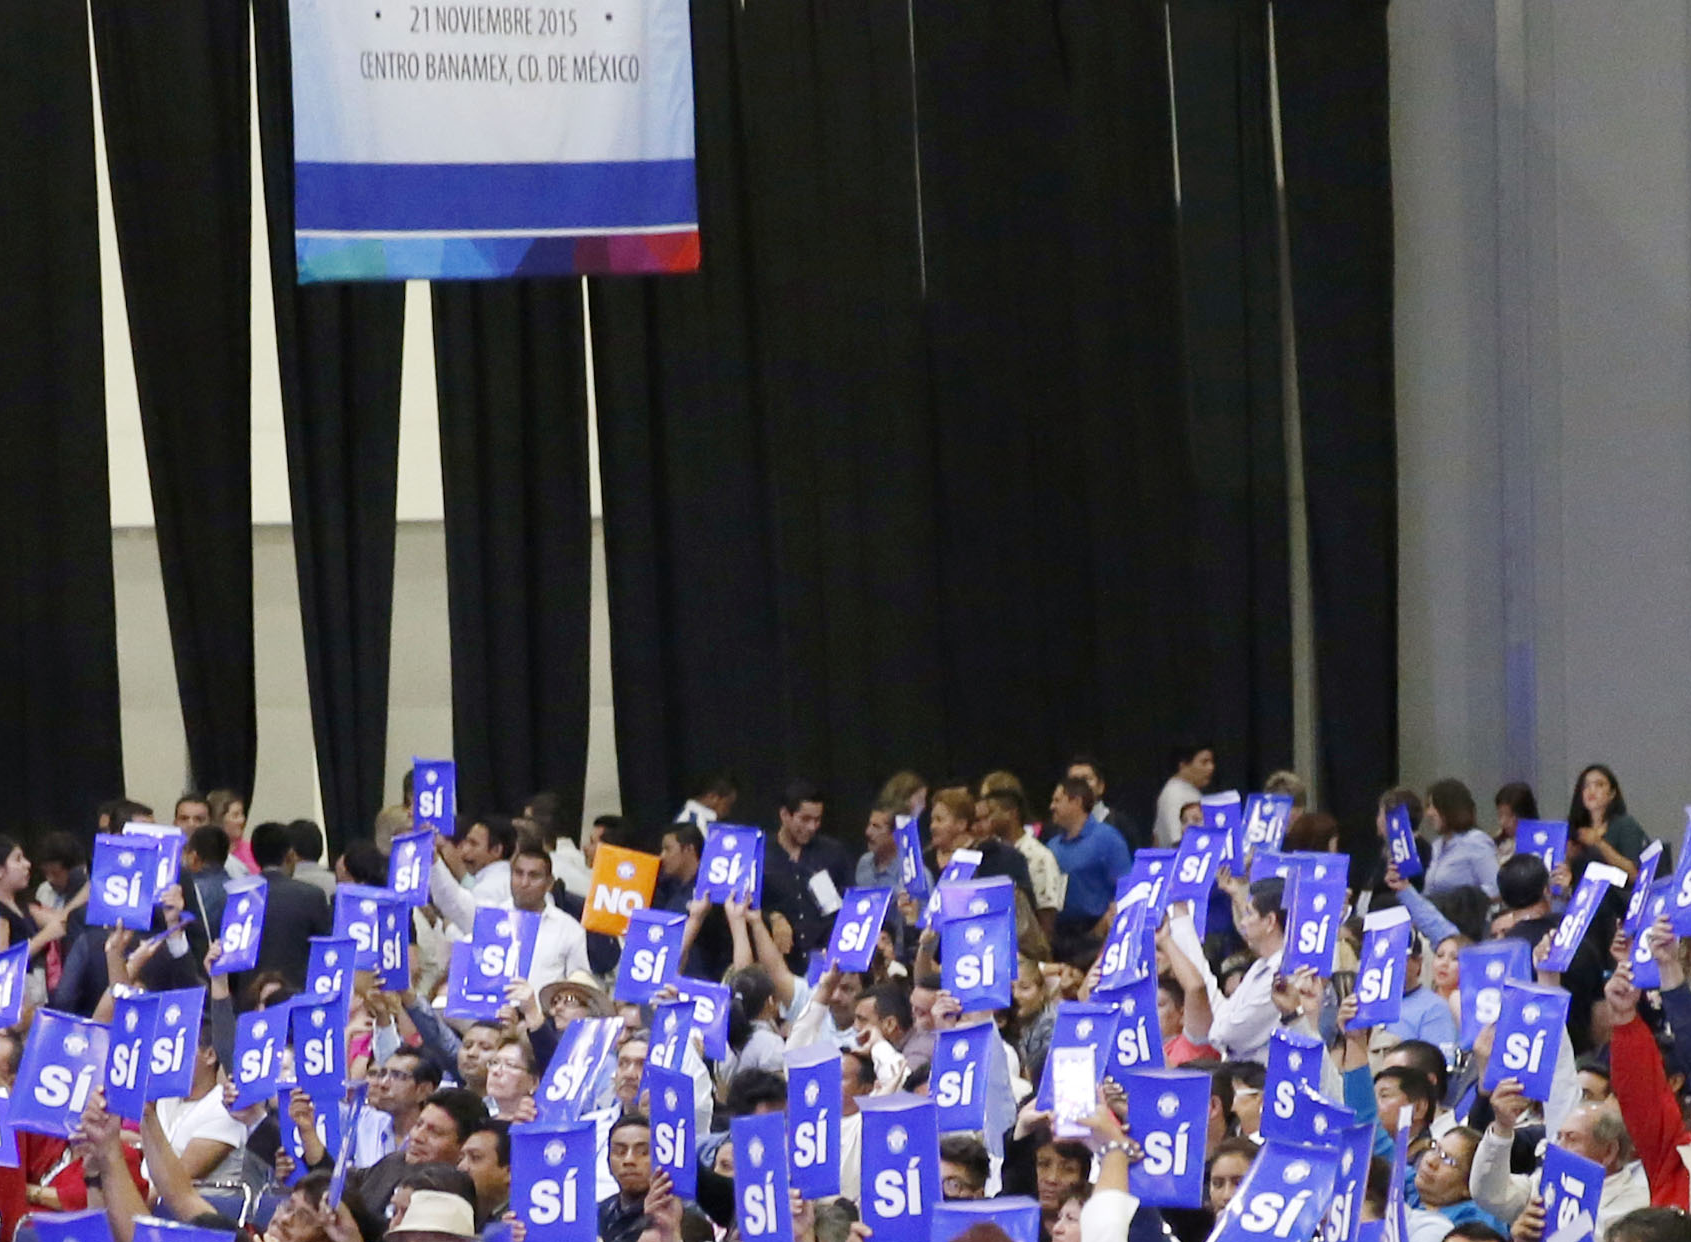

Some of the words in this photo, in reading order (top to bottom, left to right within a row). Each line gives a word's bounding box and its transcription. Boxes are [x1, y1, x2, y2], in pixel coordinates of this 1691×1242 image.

[410, 6, 431, 34] 21
[436, 7, 532, 36] NOVIEMBRE
[538, 9, 577, 37] 2015
[361, 52, 420, 80] CENTRO
[426, 53, 512, 85] BANAMEX,
[518, 55, 543, 82] CD.
[548, 56, 567, 83] DE
[573, 51, 639, 84] MÉXICO
[420, 787, 443, 817] SÍ
[1180, 852, 1212, 883] SÍ
[1393, 831, 1410, 863] SÍ
[103, 872, 142, 907] SÍ
[395, 853, 421, 892] SÍ
[593, 884, 651, 915] NO
[223, 915, 258, 957] SÍ
[383, 932, 400, 969] SÍ
[838, 916, 874, 952] SÍ
[1103, 932, 1132, 975] SÍ
[1299, 915, 1330, 953] SÍ
[477, 941, 521, 978] SÍ
[631, 946, 668, 983] SÍ
[956, 945, 994, 988] SÍ
[1359, 958, 1406, 1003] SÍ
[315, 970, 343, 994] SÍ
[151, 1028, 186, 1074] SÍ
[241, 1038, 274, 1082] SÍ
[305, 1029, 333, 1075] SÍ
[1118, 1016, 1150, 1065] SÍ
[1503, 1030, 1546, 1072] SÍ
[110, 1039, 141, 1089] SÍ
[546, 1056, 592, 1108] SÍ
[937, 1062, 975, 1107] SÍ
[35, 1064, 97, 1112] SÍ
[656, 1119, 685, 1168] SÍ
[794, 1109, 827, 1167] SÍ
[1144, 1123, 1189, 1175] SÍ
[529, 1168, 578, 1224] SÍ
[744, 1171, 776, 1235] SÍ
[874, 1157, 921, 1217] SÍ
[1241, 1190, 1312, 1237] SÍ
